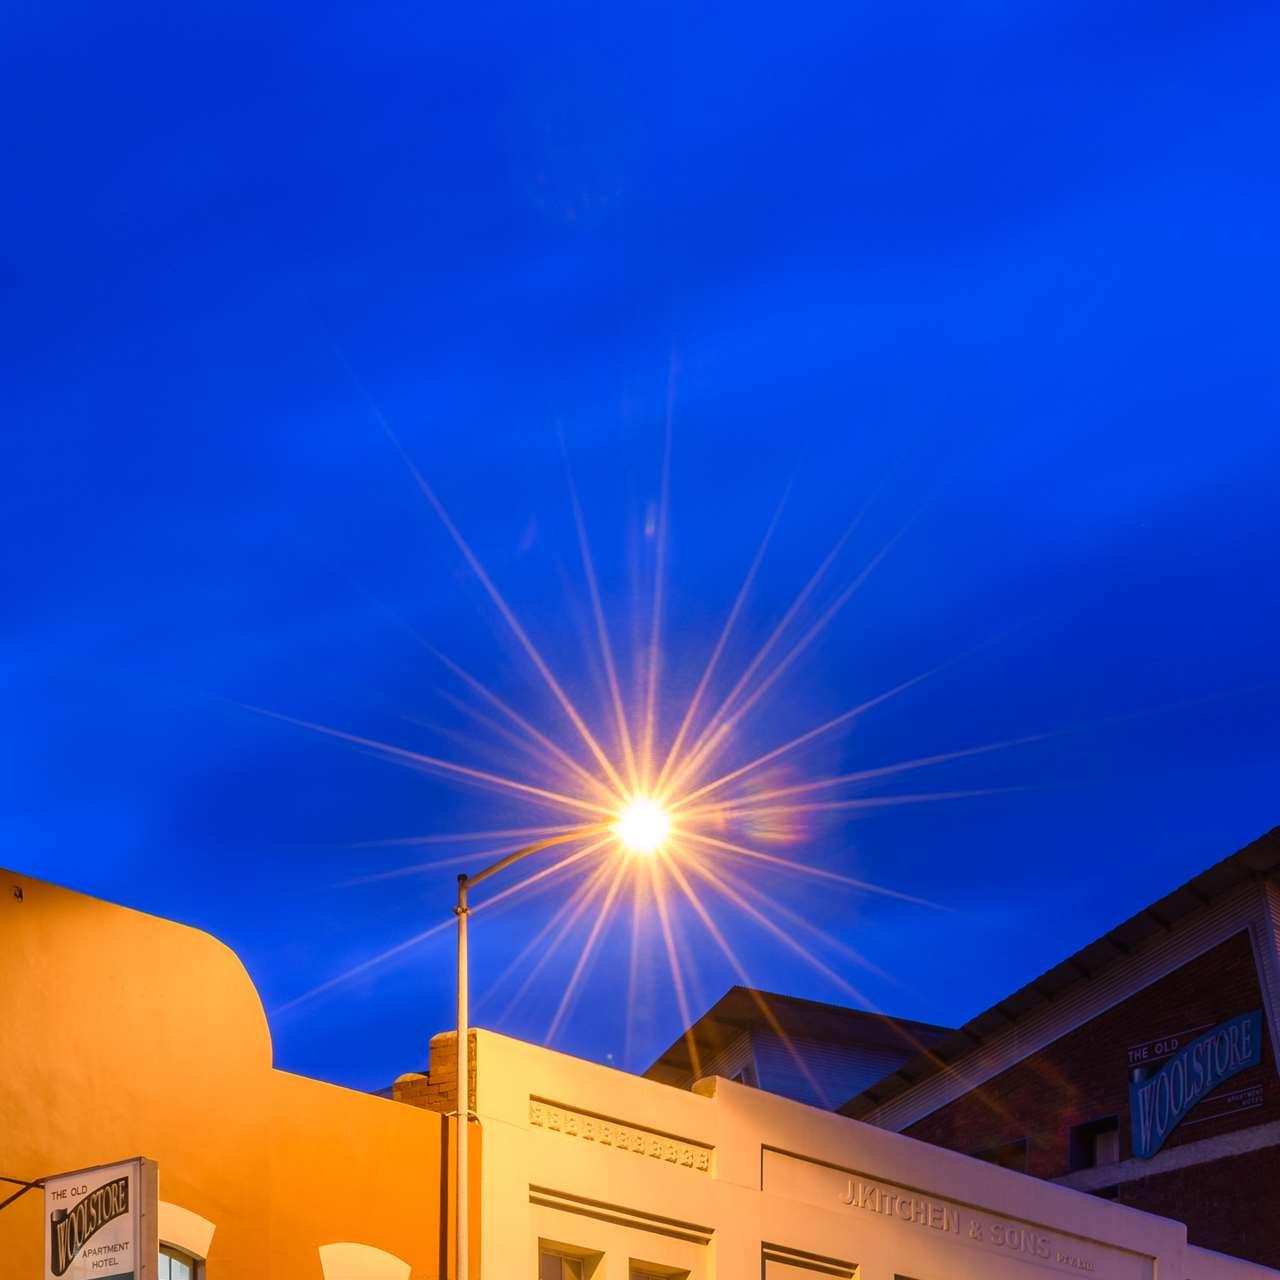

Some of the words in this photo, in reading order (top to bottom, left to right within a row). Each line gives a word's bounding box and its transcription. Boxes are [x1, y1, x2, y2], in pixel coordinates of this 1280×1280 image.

[1129, 1049, 1148, 1063] THE
[1155, 1039, 1178, 1055] OLD
[1139, 1019, 1253, 1154] WOOLSTORE
[51, 1187, 68, 1201] THE
[70, 1184, 88, 1198] OLD
[57, 1180, 127, 1271] WOOLSTORE
[82, 1241, 130, 1259] APARTMENT
[968, 1219, 984, 1241] &
[990, 1224, 1052, 1261] SONS
[92, 1257, 119, 1270] HOTEL
